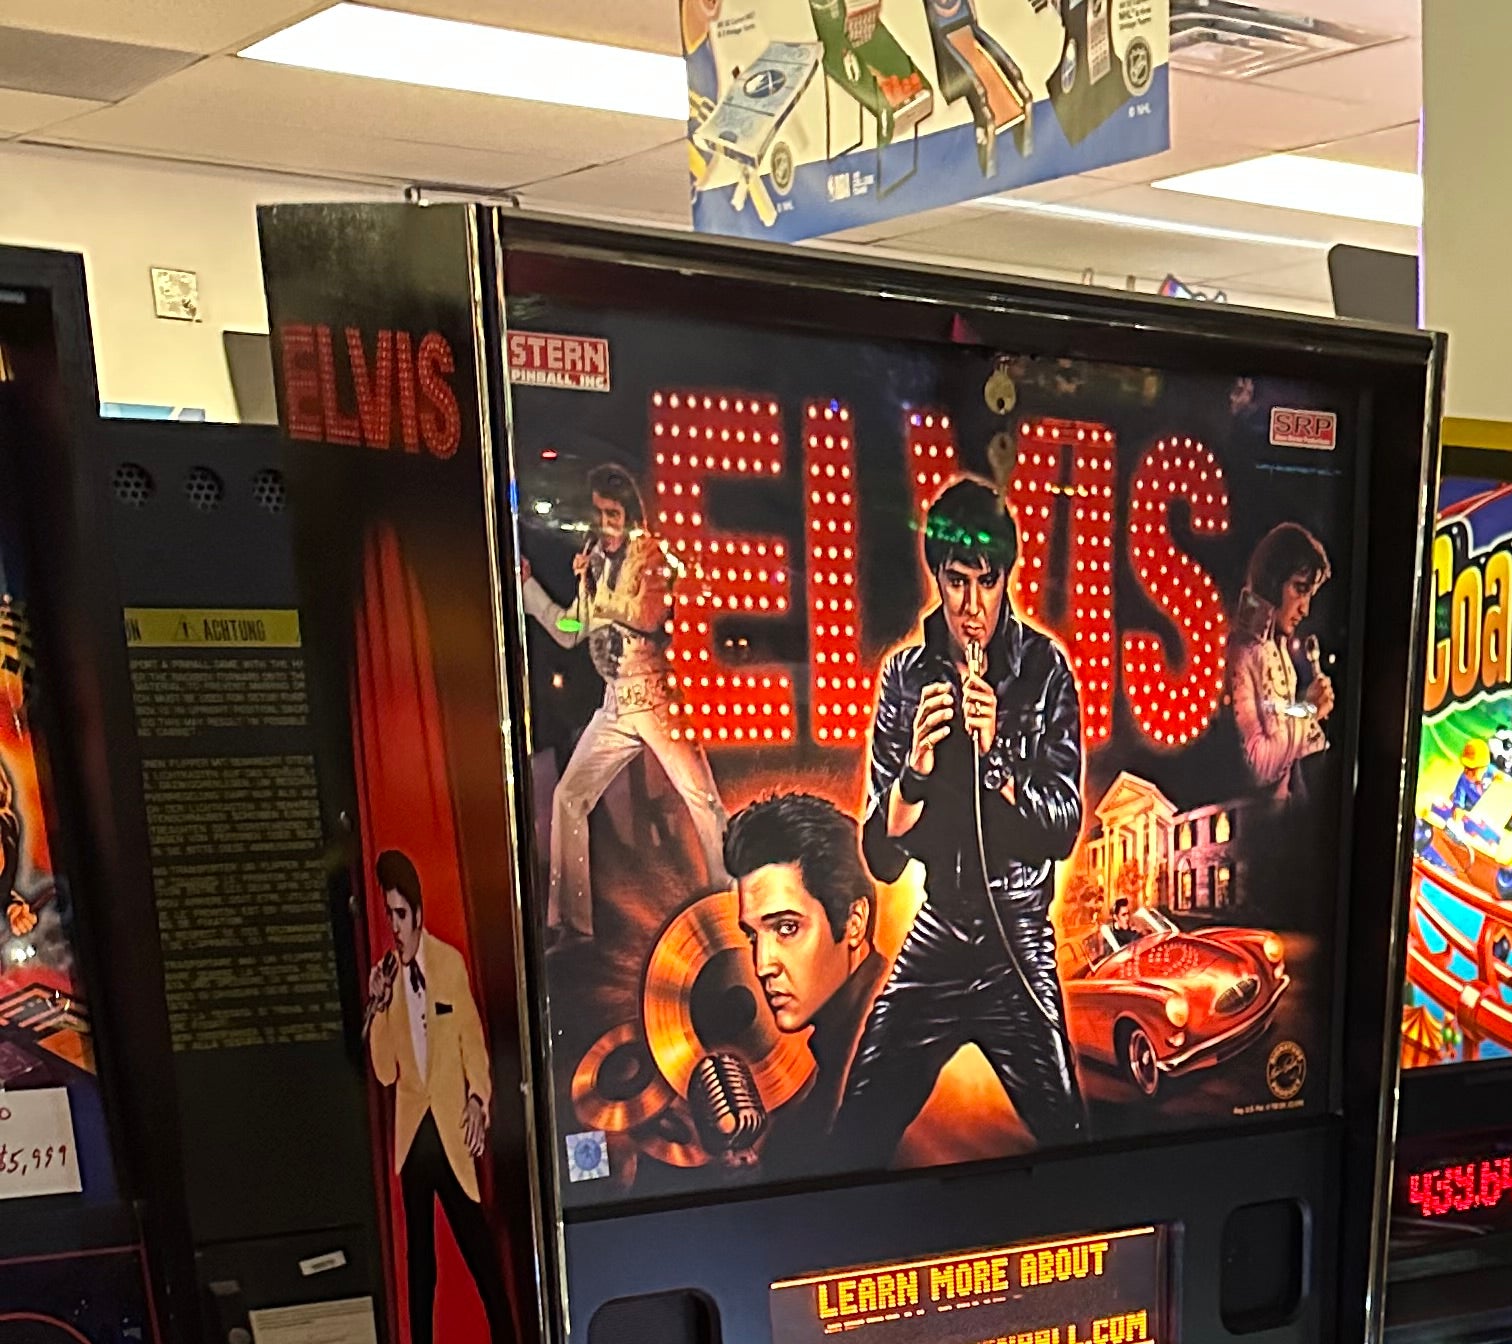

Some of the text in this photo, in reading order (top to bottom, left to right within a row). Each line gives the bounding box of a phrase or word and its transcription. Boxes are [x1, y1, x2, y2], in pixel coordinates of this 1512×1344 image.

[510, 335, 605, 373] STERN
[280, 323, 462, 461] ELVIS
[1274, 412, 1333, 437] SRP
[203, 618, 266, 642] ACHTUNG
[817, 1241, 1110, 1320] LEARN MORE ABOUT
